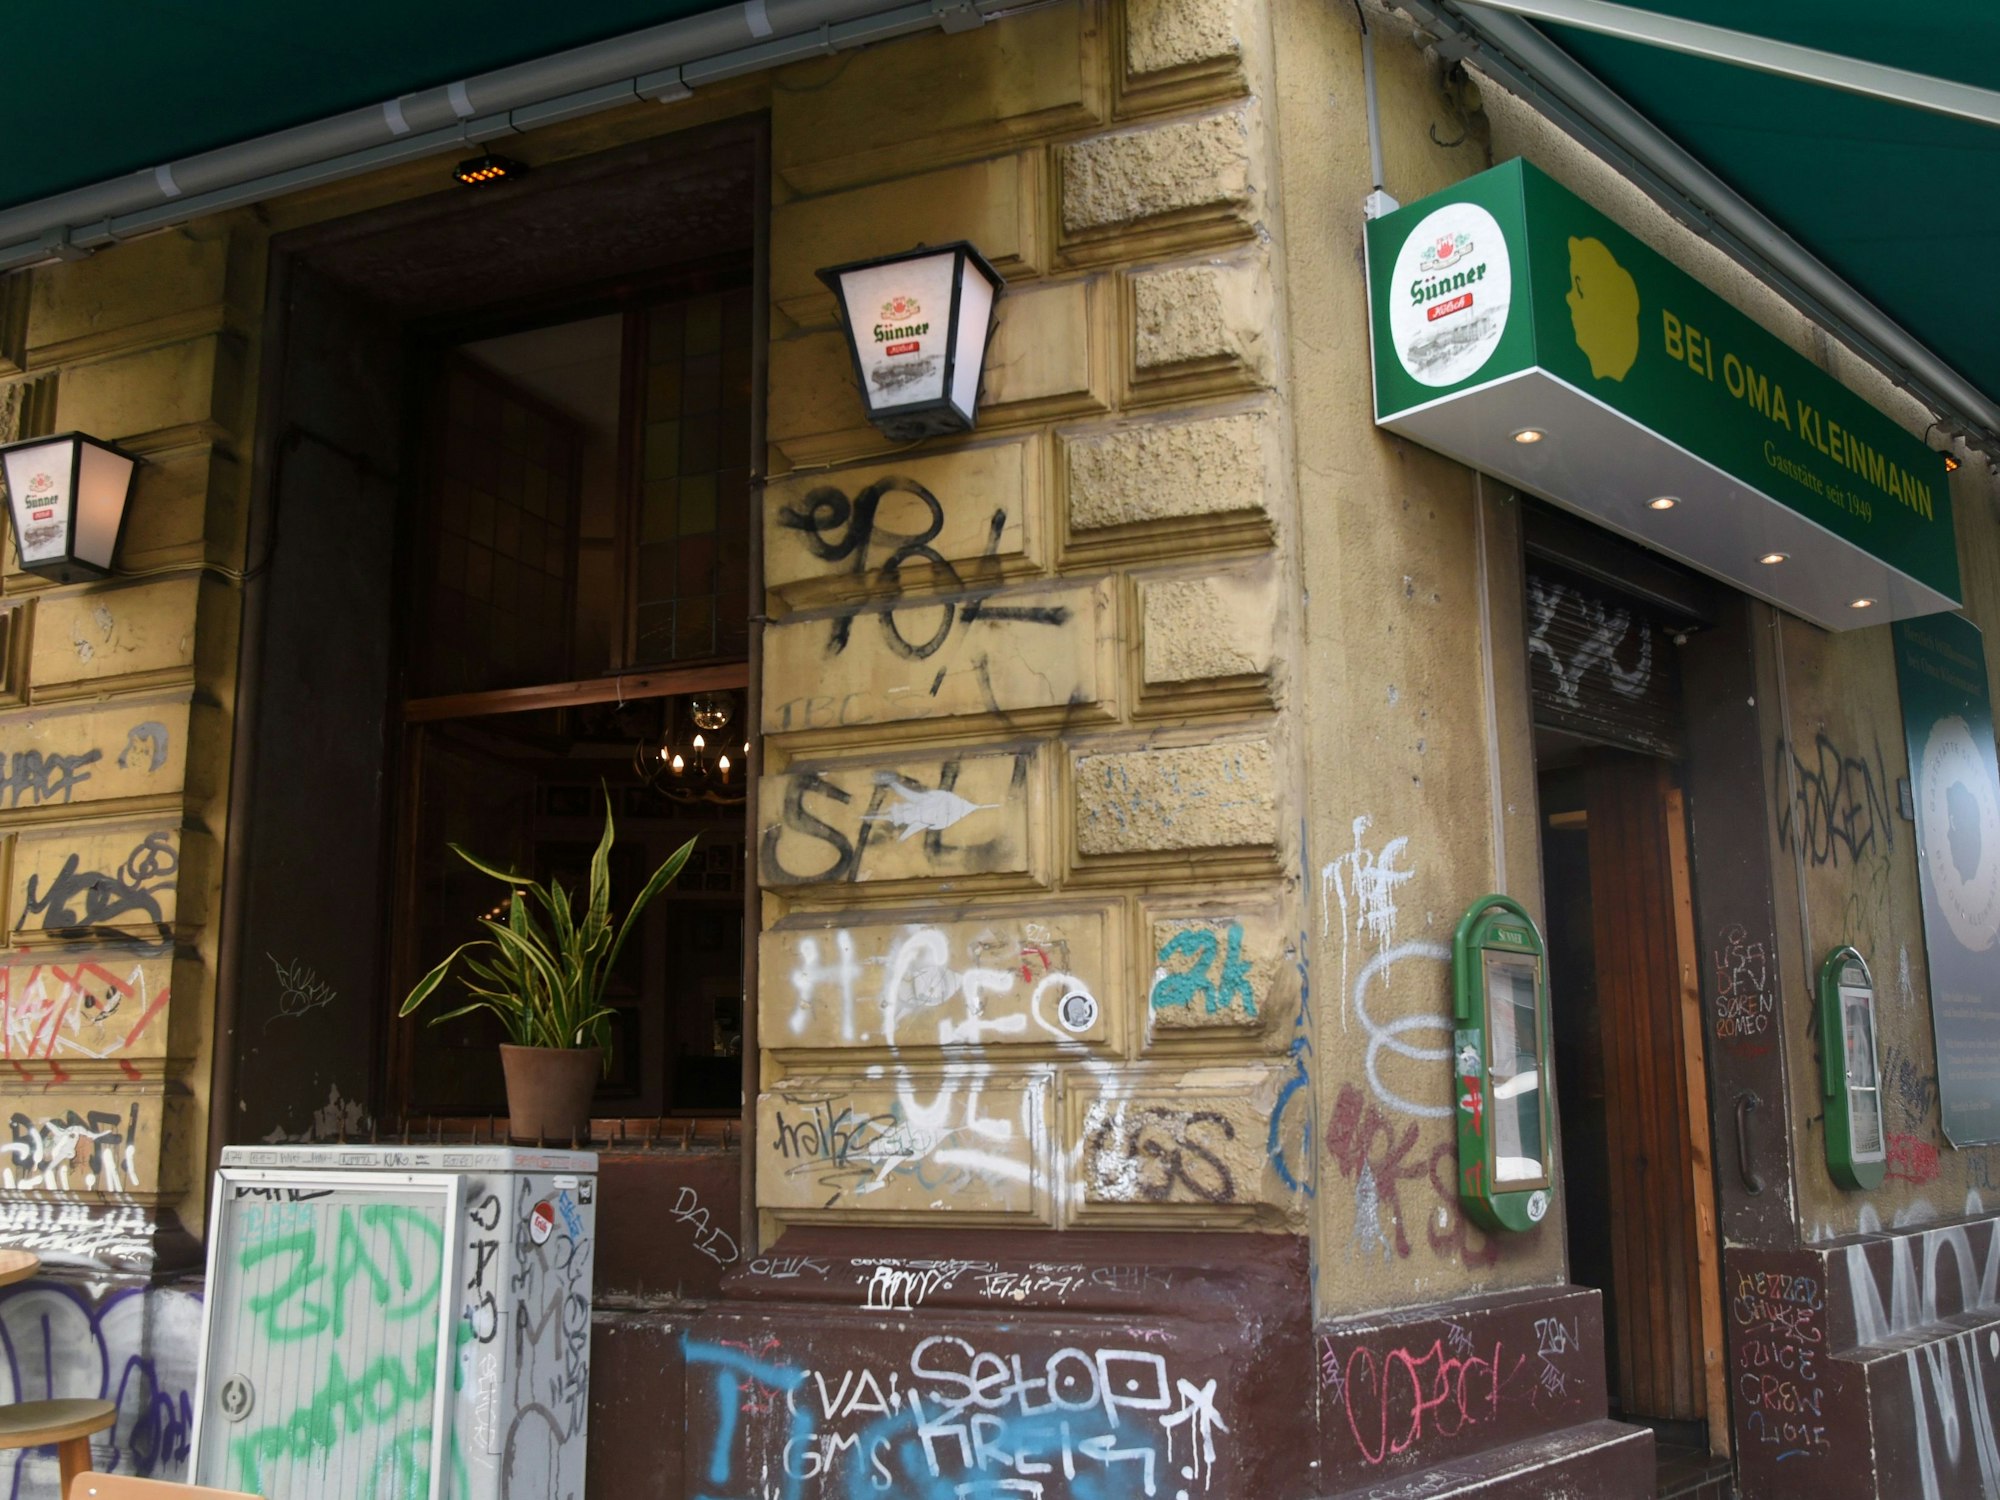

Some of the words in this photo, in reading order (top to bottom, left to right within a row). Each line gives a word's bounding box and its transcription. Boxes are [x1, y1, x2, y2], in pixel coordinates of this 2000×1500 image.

[1410, 262, 1487, 306] Sünner
[873, 321, 930, 343] Sünner
[1662, 308, 1714, 382] BEI
[1722, 352, 1792, 432] OMA
[1796, 399, 1934, 522] KLEINMANN
[1763, 439, 1824, 495] Gaststätte
[1826, 483, 1846, 506] seit
[1846, 491, 1873, 524] 1949
